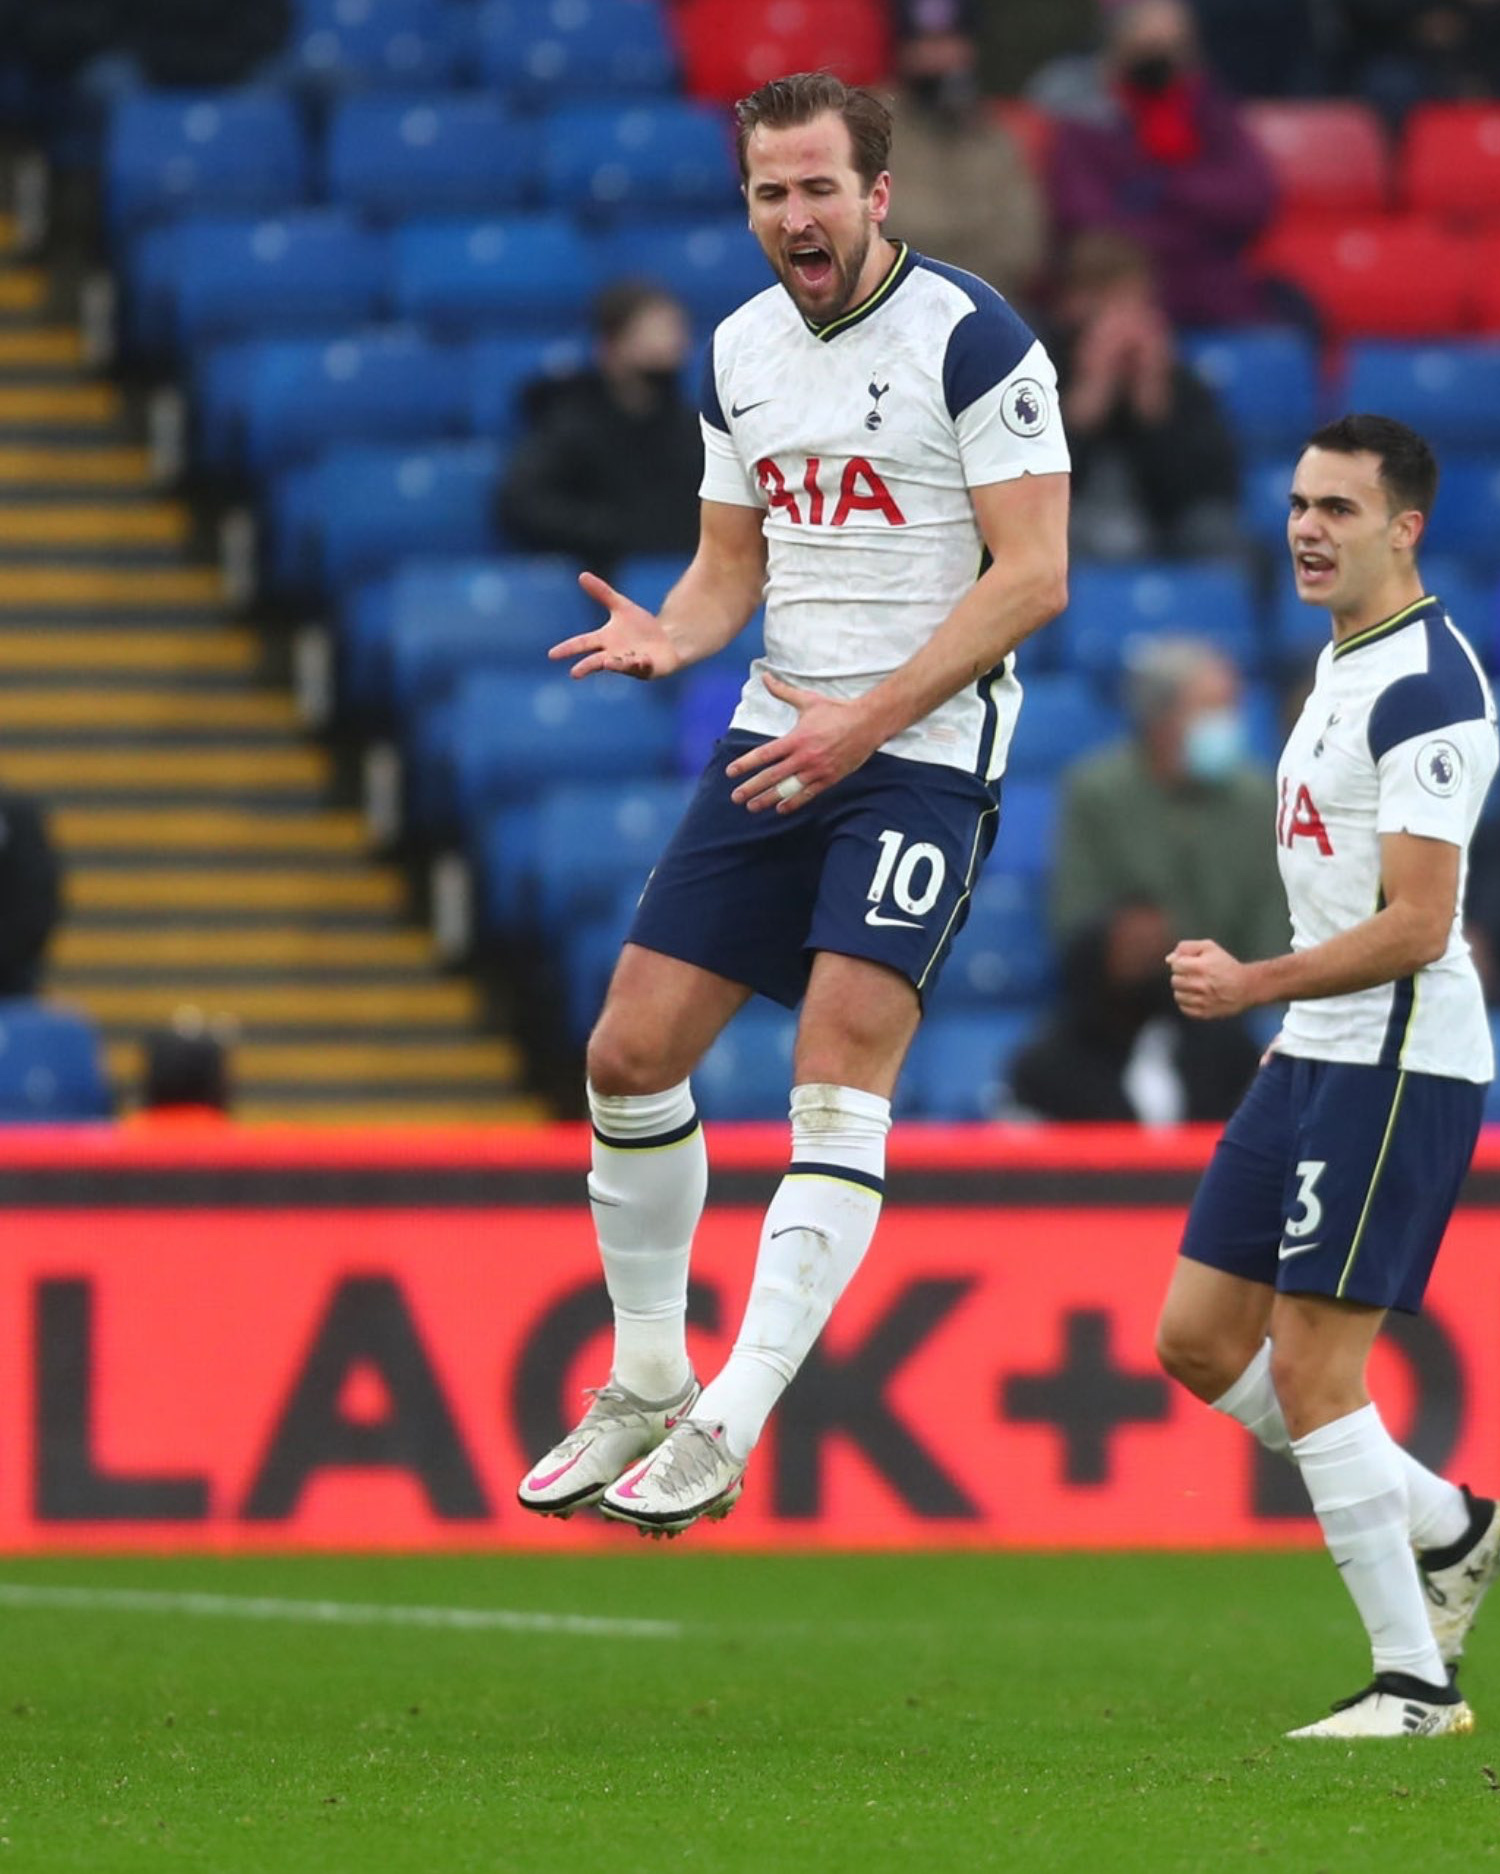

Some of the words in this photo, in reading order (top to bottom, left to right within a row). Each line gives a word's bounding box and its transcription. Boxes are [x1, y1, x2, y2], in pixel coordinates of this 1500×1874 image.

[757, 455, 908, 527] AIA
[866, 829, 946, 916] 10
[1284, 1160, 1327, 1238] 3
